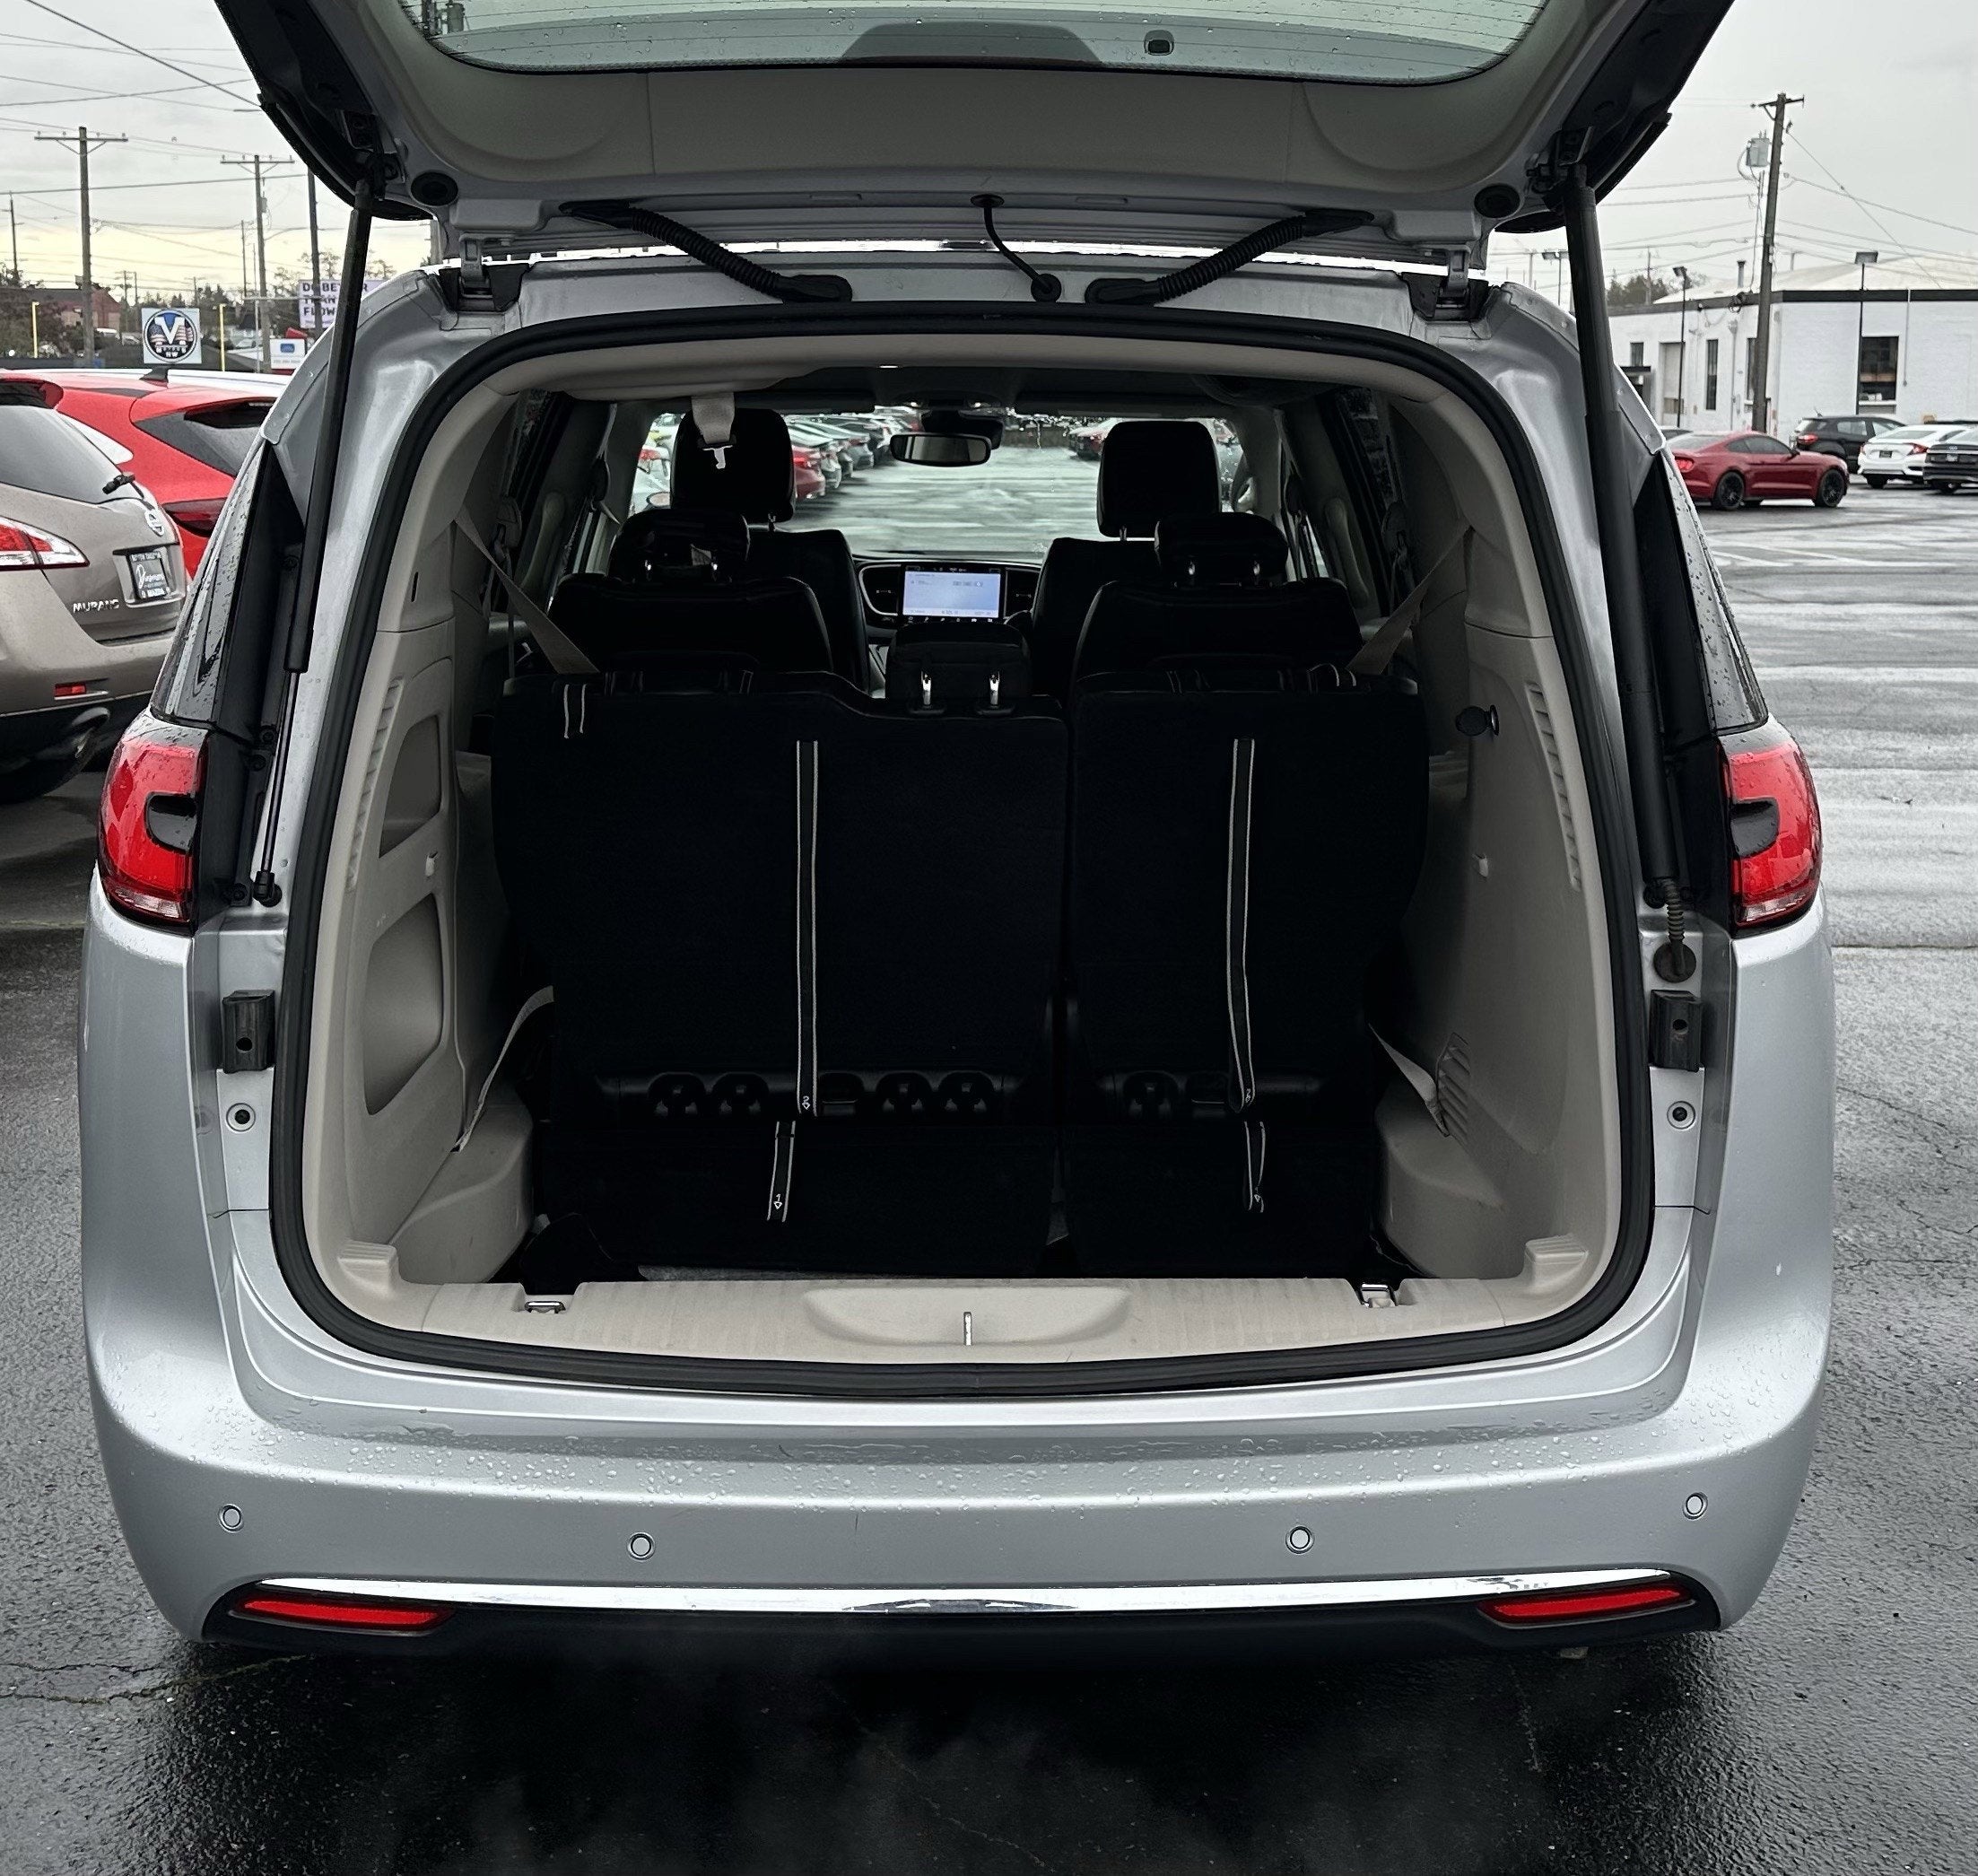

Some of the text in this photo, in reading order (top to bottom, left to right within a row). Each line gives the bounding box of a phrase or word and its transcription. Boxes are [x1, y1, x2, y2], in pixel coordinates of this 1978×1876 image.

[303, 295, 336, 304] TAN
[154, 317, 185, 345] V
[73, 598, 120, 614] MURANO
[775, 1193, 781, 1202] 1
